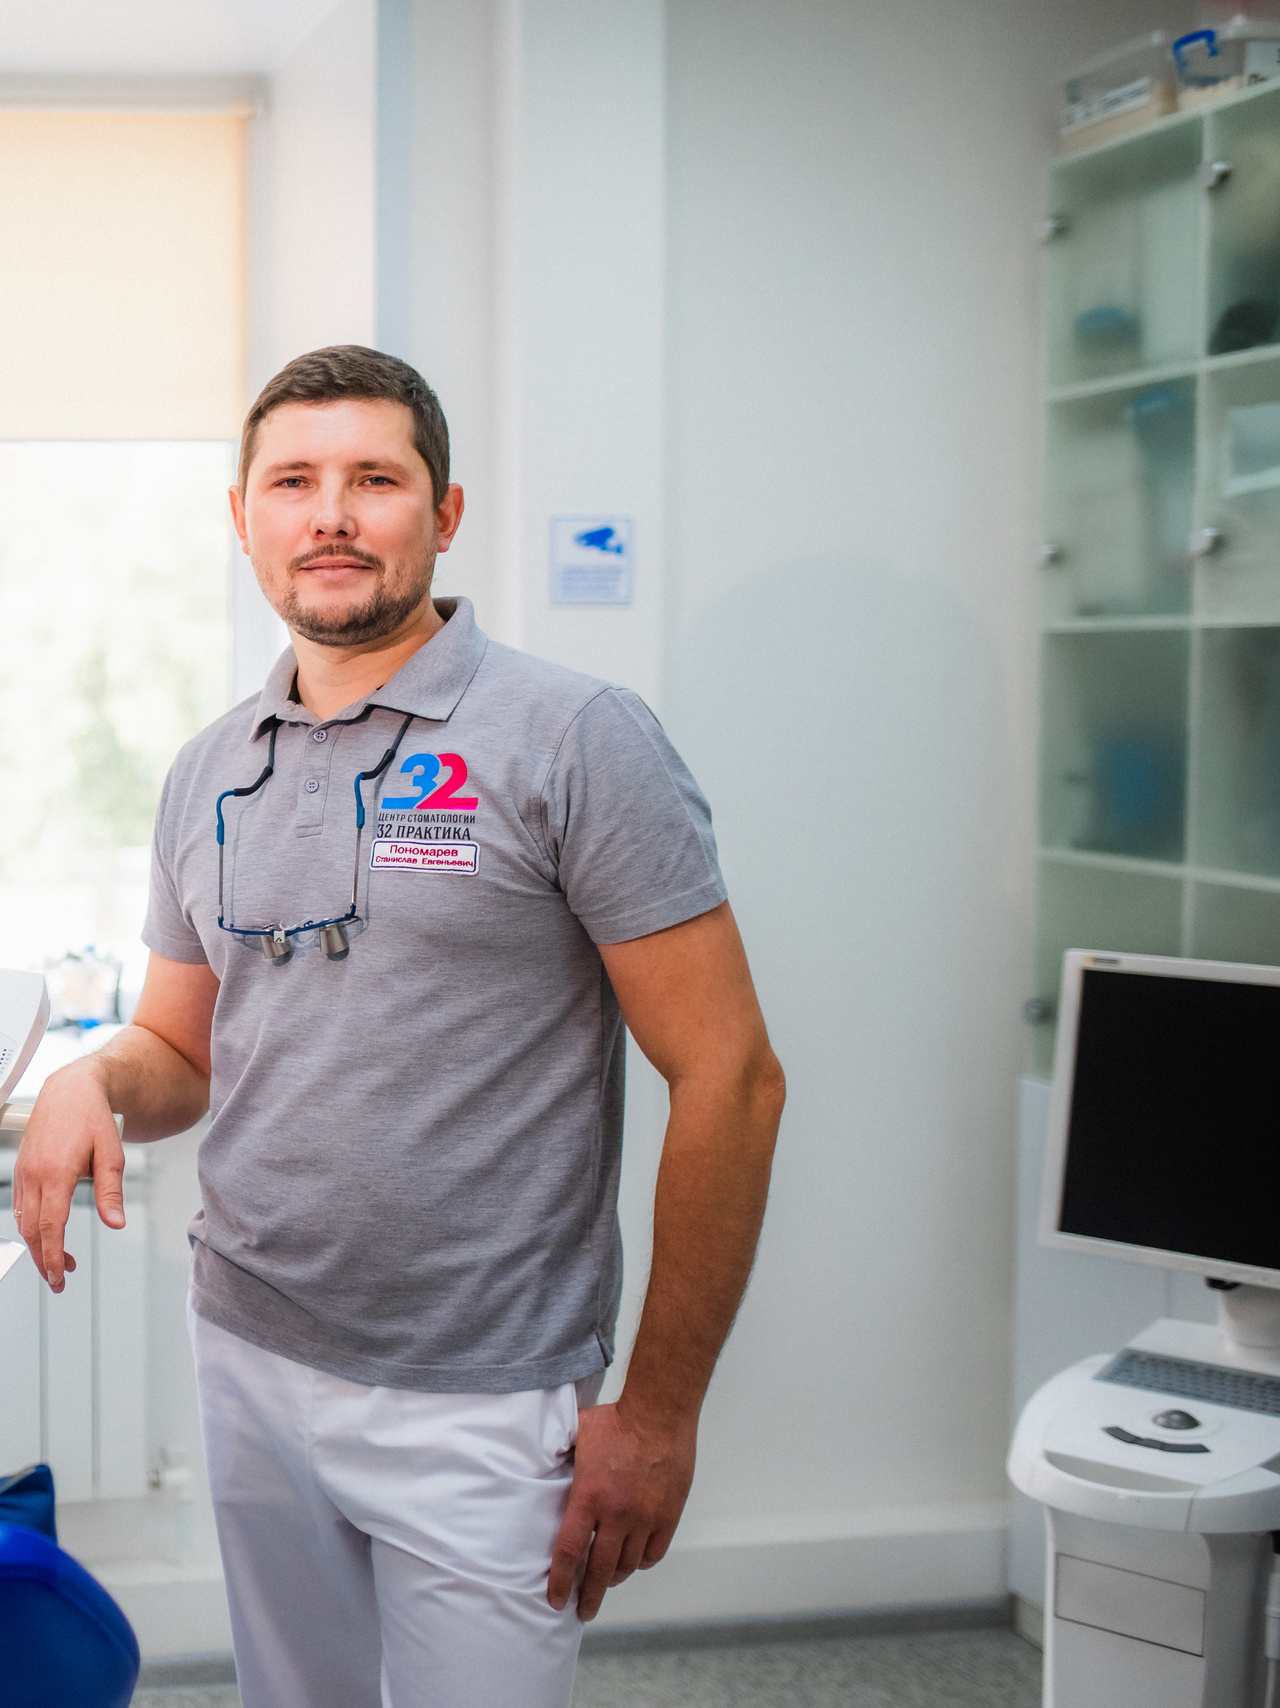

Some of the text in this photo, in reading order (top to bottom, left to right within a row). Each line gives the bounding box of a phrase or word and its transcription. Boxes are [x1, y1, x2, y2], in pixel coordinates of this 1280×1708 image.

[381, 752, 478, 810] 32
[378, 812, 476, 824] ЦЕНТР СТОМАТОЛОГИИ
[376, 823, 471, 840] 32 ПРАКТИКА
[390, 845, 458, 857] Пономарев
[375, 855, 474, 867] Станислав Евгеньевич
